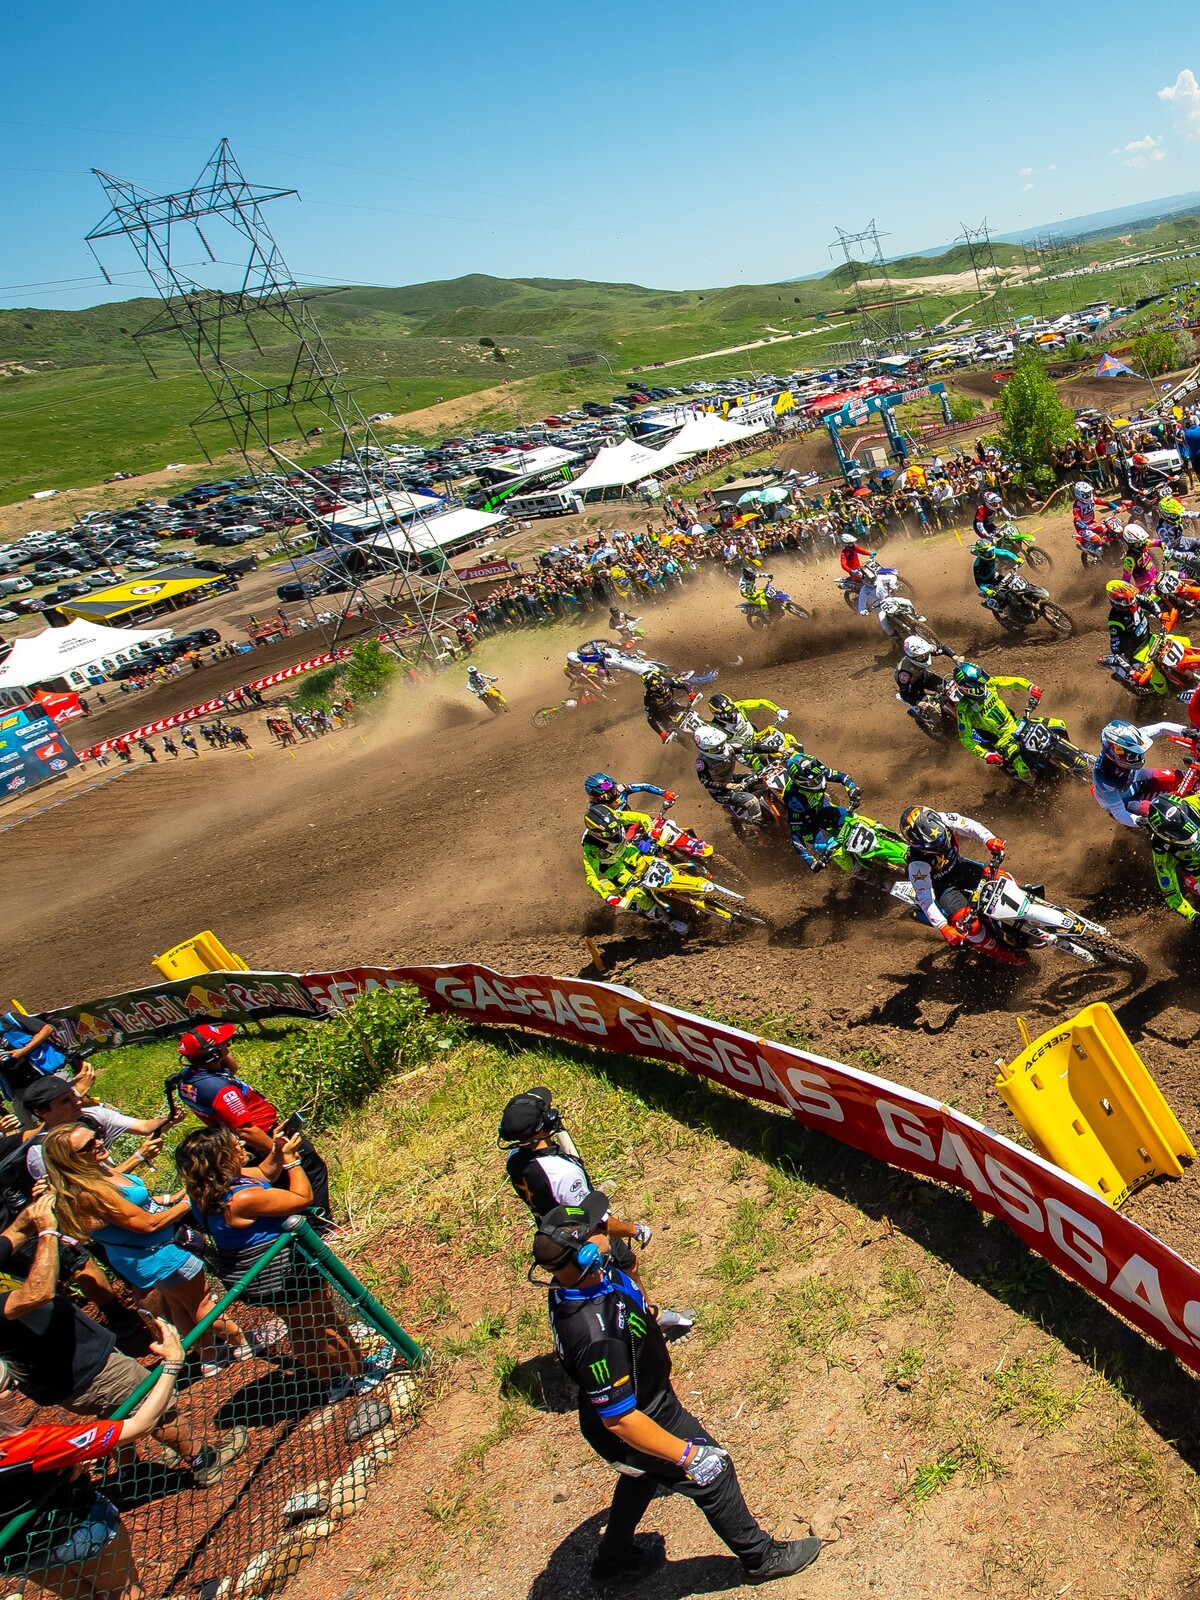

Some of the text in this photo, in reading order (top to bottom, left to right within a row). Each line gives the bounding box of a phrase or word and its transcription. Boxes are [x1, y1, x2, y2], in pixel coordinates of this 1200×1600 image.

[902, 386, 931, 402] LUCAS OIL
[469, 563, 509, 579] HONDA
[1165, 575, 1179, 593] 43
[1167, 641, 1184, 664] 97
[979, 697, 997, 716] THOR
[15, 720, 48, 737] GEICO
[686, 718, 700, 732] 15
[1029, 724, 1050, 750] 29
[852, 826, 875, 854] 13
[649, 862, 671, 888] 34
[1001, 893, 1020, 912] 1
[226, 982, 315, 1013] RedBull
[435, 976, 607, 1036] GASGAS
[112, 995, 189, 1033] RedBull
[1025, 1032, 1072, 1072] ACERBIS
[618, 1006, 845, 1123] GASGAS
